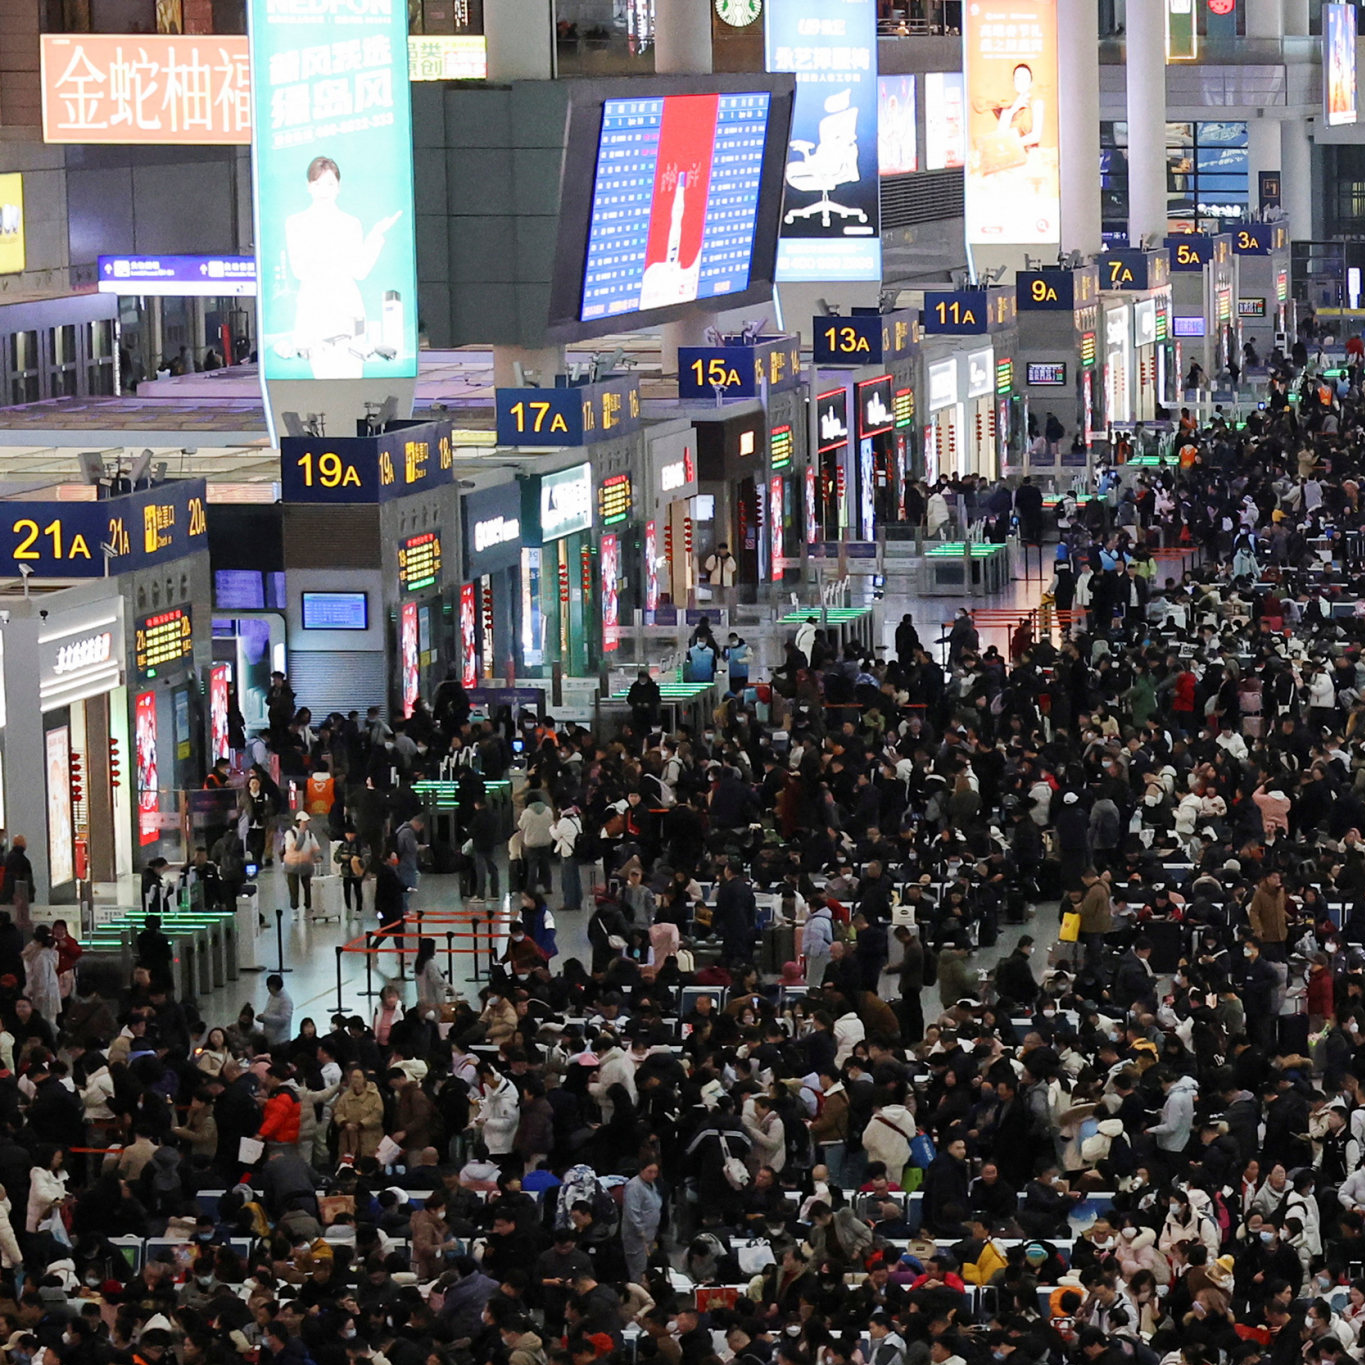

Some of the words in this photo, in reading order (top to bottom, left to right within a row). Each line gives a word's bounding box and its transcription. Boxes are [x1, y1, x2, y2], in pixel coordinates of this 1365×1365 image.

[1239, 231, 1259, 249] 3A
[1178, 244, 1200, 264] 5A
[1109, 261, 1133, 281] 7A
[1032, 280, 1058, 302] 9A
[936, 302, 975, 324] 11A
[824, 327, 870, 352] 13A
[691, 358, 741, 386] 15A
[510, 401, 568, 432] 17A
[297, 452, 362, 488] 19A
[378, 451, 395, 485] 19A
[188, 498, 207, 536] 20A
[12, 519, 91, 560] 21A
